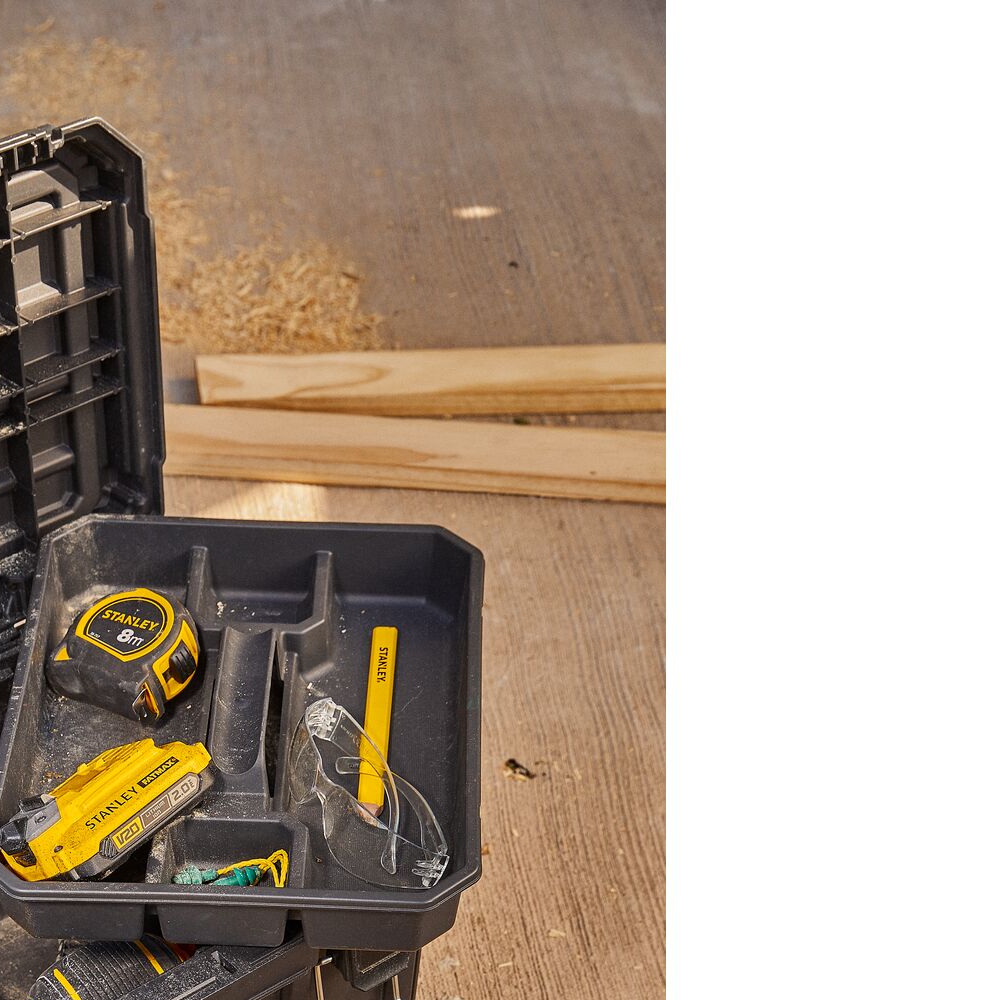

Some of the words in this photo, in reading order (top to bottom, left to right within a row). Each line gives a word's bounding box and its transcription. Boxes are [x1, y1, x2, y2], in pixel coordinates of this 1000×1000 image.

[102, 609, 159, 632] STANLEY
[117, 627, 144, 648] 8m
[377, 647, 388, 682] STANLEY
[84, 785, 139, 831] STANLEY
[141, 758, 174, 785] FATMAX
